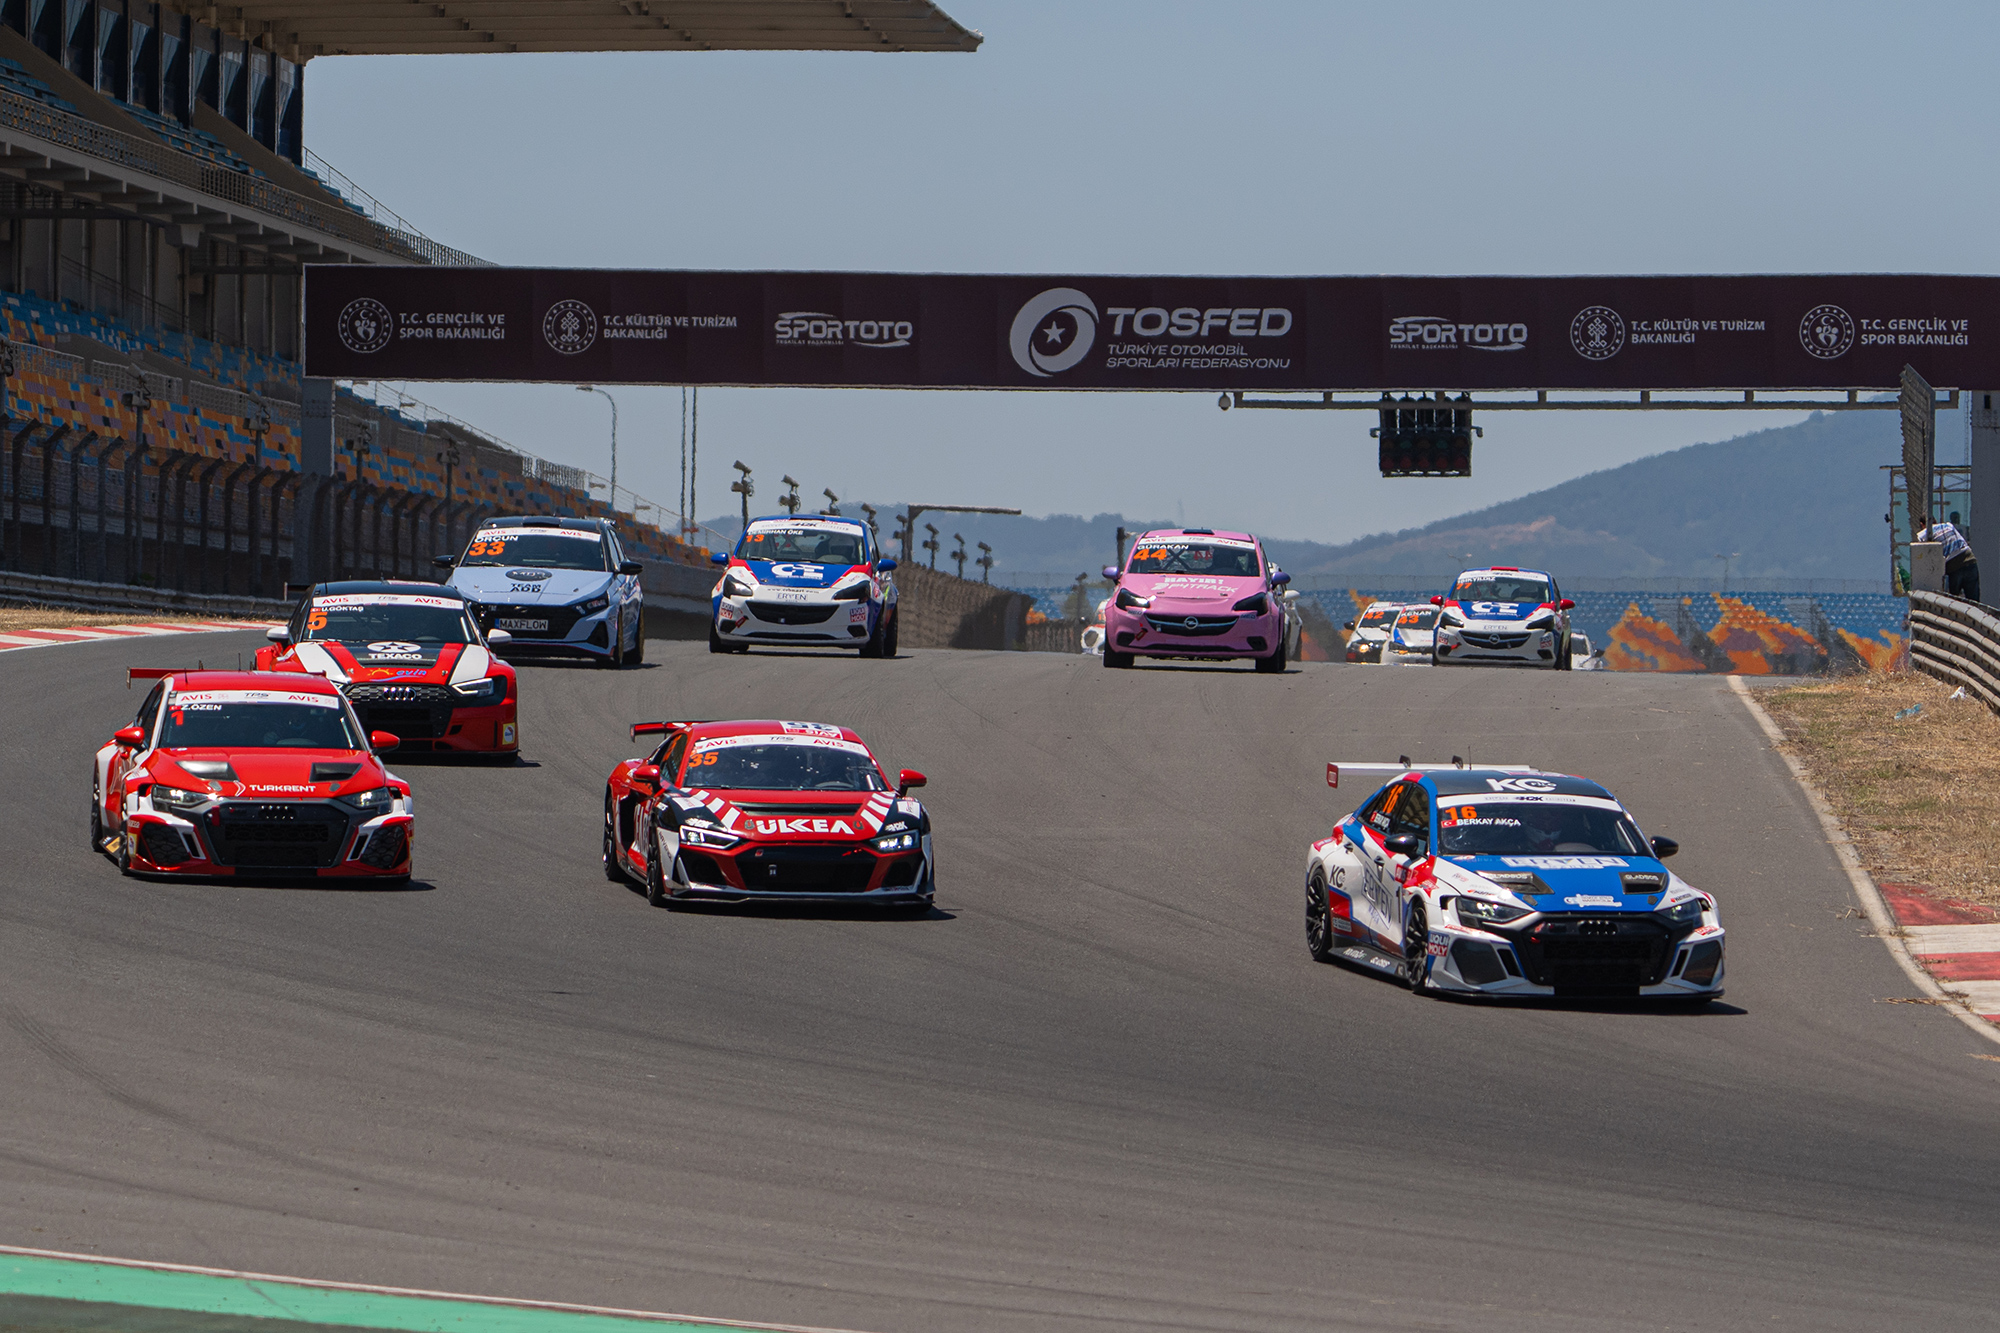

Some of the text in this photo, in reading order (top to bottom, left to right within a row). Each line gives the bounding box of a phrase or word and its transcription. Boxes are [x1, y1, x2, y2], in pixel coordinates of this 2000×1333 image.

[399, 311, 505, 327] T.C. GENÇLİK VE
[603, 313, 737, 327] T.C. KÜLTÜR VE TURİZM
[1106, 307, 1293, 337] TOSFED
[1630, 318, 1766, 331] T.C. KÜLTÜR VE TURİZM
[1860, 316, 1969, 333] T.C. GENÇLİK VE
[399, 326, 505, 340] SPOR BAKANLIĞI
[603, 326, 668, 339] BAKANLIĞI
[1631, 331, 1695, 344] BAKANLIĞI
[1860, 332, 1969, 346] SPOR BAKANLIĞI
[1108, 342, 1248, 356] TÜRKİYE OTOMOBİL
[1106, 357, 1291, 369] SPORLARI FEDERASYONU
[745, 534, 765, 543] 13
[468, 541, 506, 557] 33
[1133, 548, 1168, 561] 44
[321, 597, 349, 605] AVIS
[414, 597, 442, 606] AVIS
[306, 611, 328, 631] 5
[1363, 610, 1385, 620] 42
[1397, 615, 1420, 625] 43
[499, 619, 547, 630] MAXFLOW
[180, 693, 213, 702] AVIS
[287, 694, 320, 703] AVIS
[171, 710, 184, 726] 1
[705, 738, 738, 749] AVIS
[813, 738, 845, 749] AVIS
[688, 751, 719, 768] 35
[248, 784, 317, 793] TURKRENT
[1382, 784, 1404, 814] 16
[1444, 806, 1478, 821] 16
[1456, 818, 1522, 827] BERKAY AKÇA
[1430, 933, 1449, 946] LIQUI
[1428, 943, 1447, 956] MOLY
